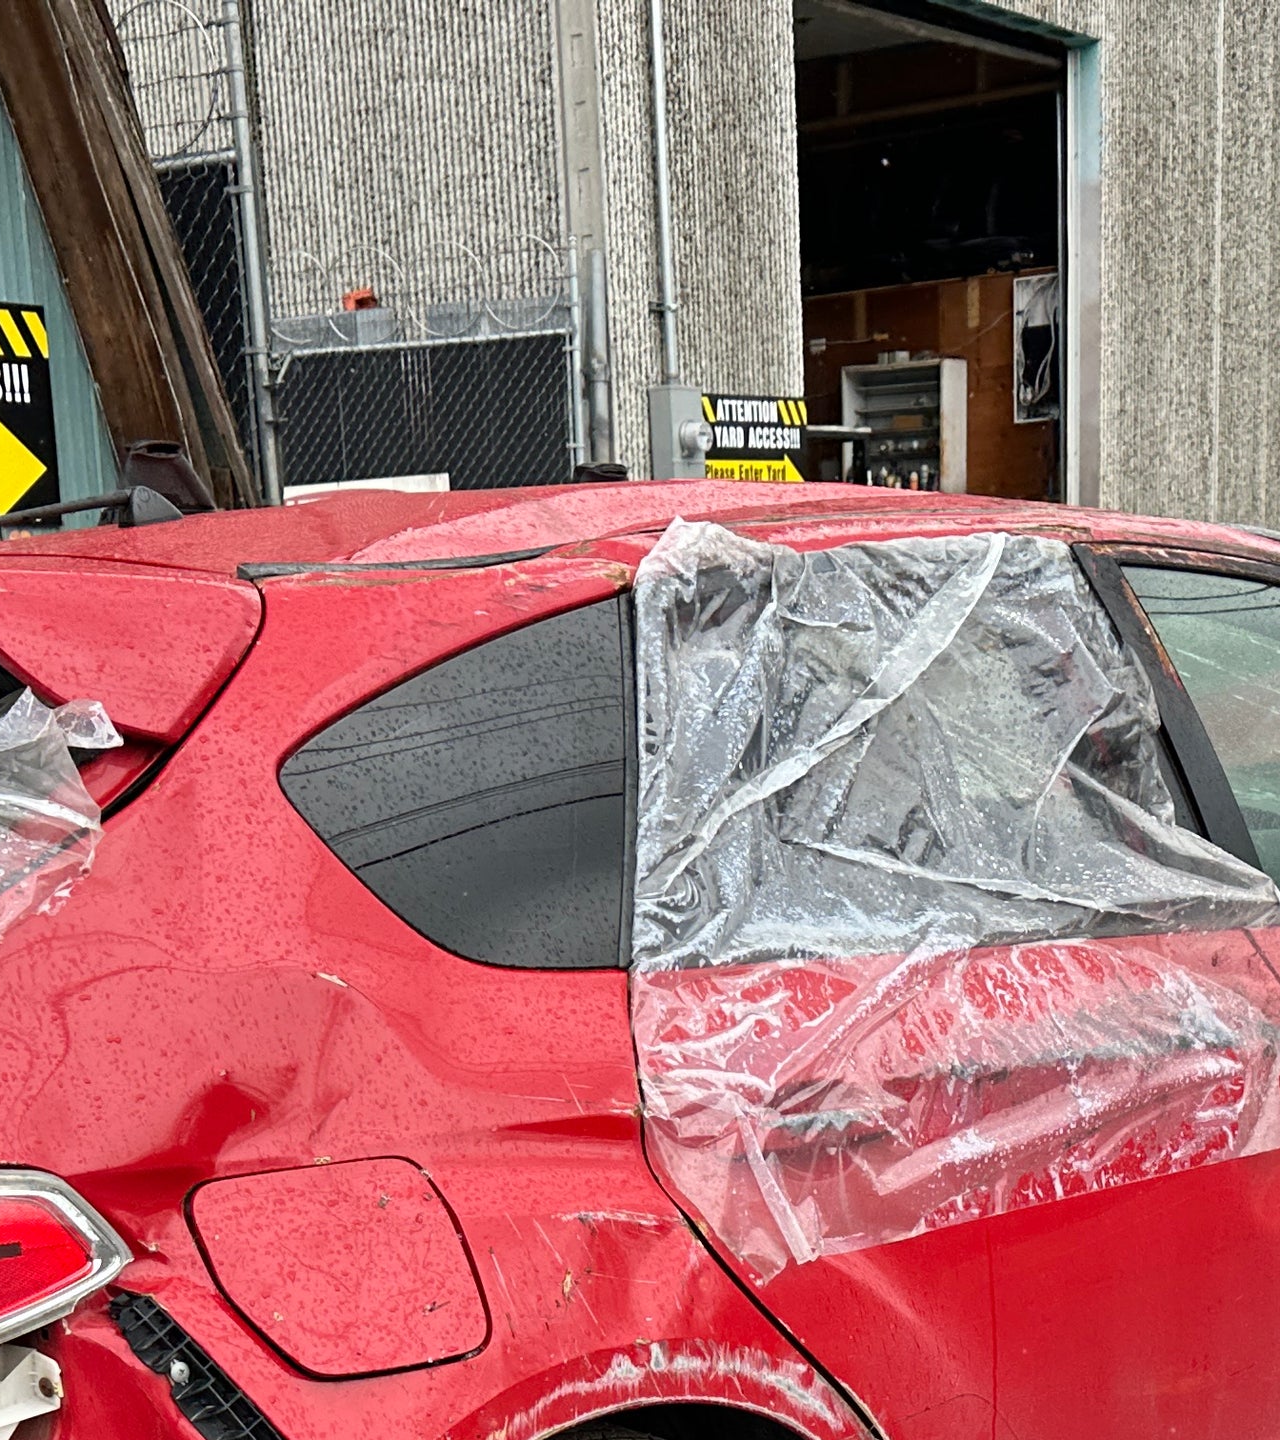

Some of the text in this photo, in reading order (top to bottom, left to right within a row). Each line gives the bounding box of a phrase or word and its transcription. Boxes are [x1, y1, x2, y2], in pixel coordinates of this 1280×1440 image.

[716, 398, 779, 423] ATTENTION
[714, 426, 801, 450] YARD ACCESS!!!
[705, 463, 787, 481] Please Enter Yard
